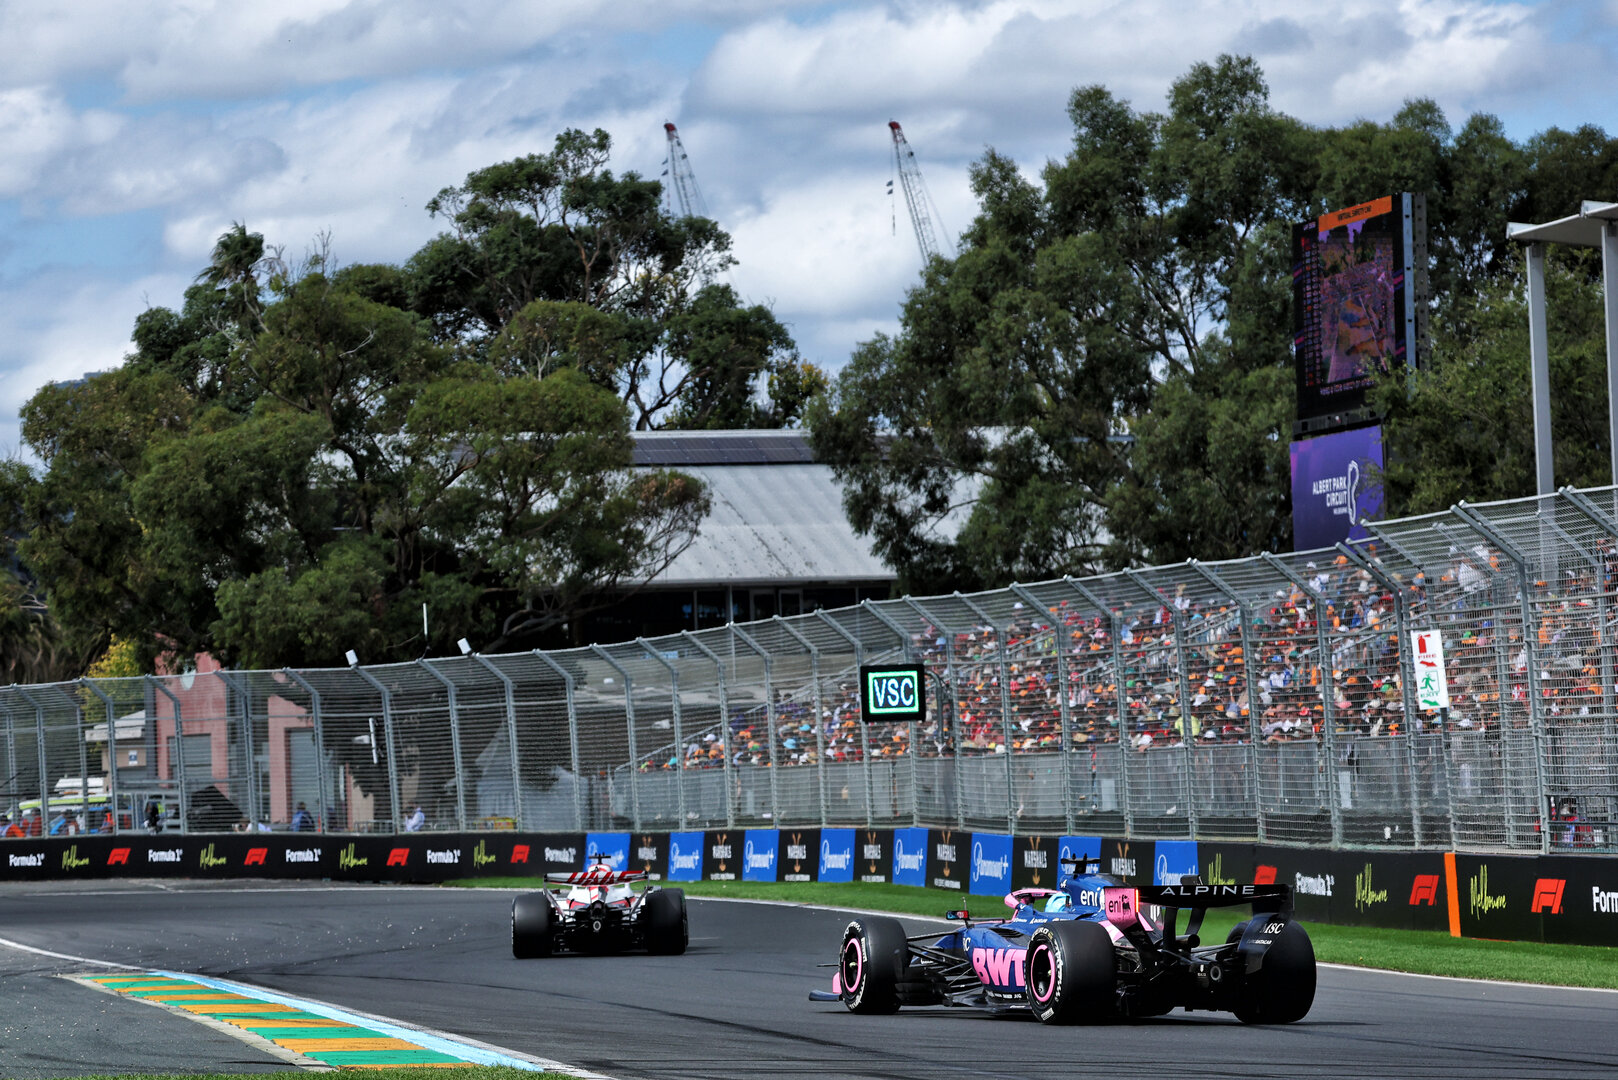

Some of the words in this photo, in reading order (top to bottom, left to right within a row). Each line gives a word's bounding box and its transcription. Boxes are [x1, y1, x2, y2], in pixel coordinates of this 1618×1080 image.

[1313, 479, 1332, 495] ALBERT
[1333, 477, 1347, 491] PARK
[1326, 491, 1347, 507] CIRCUIT
[874, 677, 913, 707] VSC
[9, 853, 36, 866] Formula
[148, 849, 175, 862] Formula
[286, 849, 313, 862] Formula
[427, 849, 453, 863] Formula
[1024, 850, 1047, 869] MARSHALS
[1111, 857, 1136, 876] MARSHALS
[1081, 887, 1100, 907] eni
[1160, 885, 1255, 896] ALPINE
[1409, 875, 1440, 906] F1
[1471, 864, 1507, 920] Melbourne
[1531, 878, 1567, 914] F1
[1109, 896, 1121, 913] eni
[972, 948, 1028, 987] BWT
